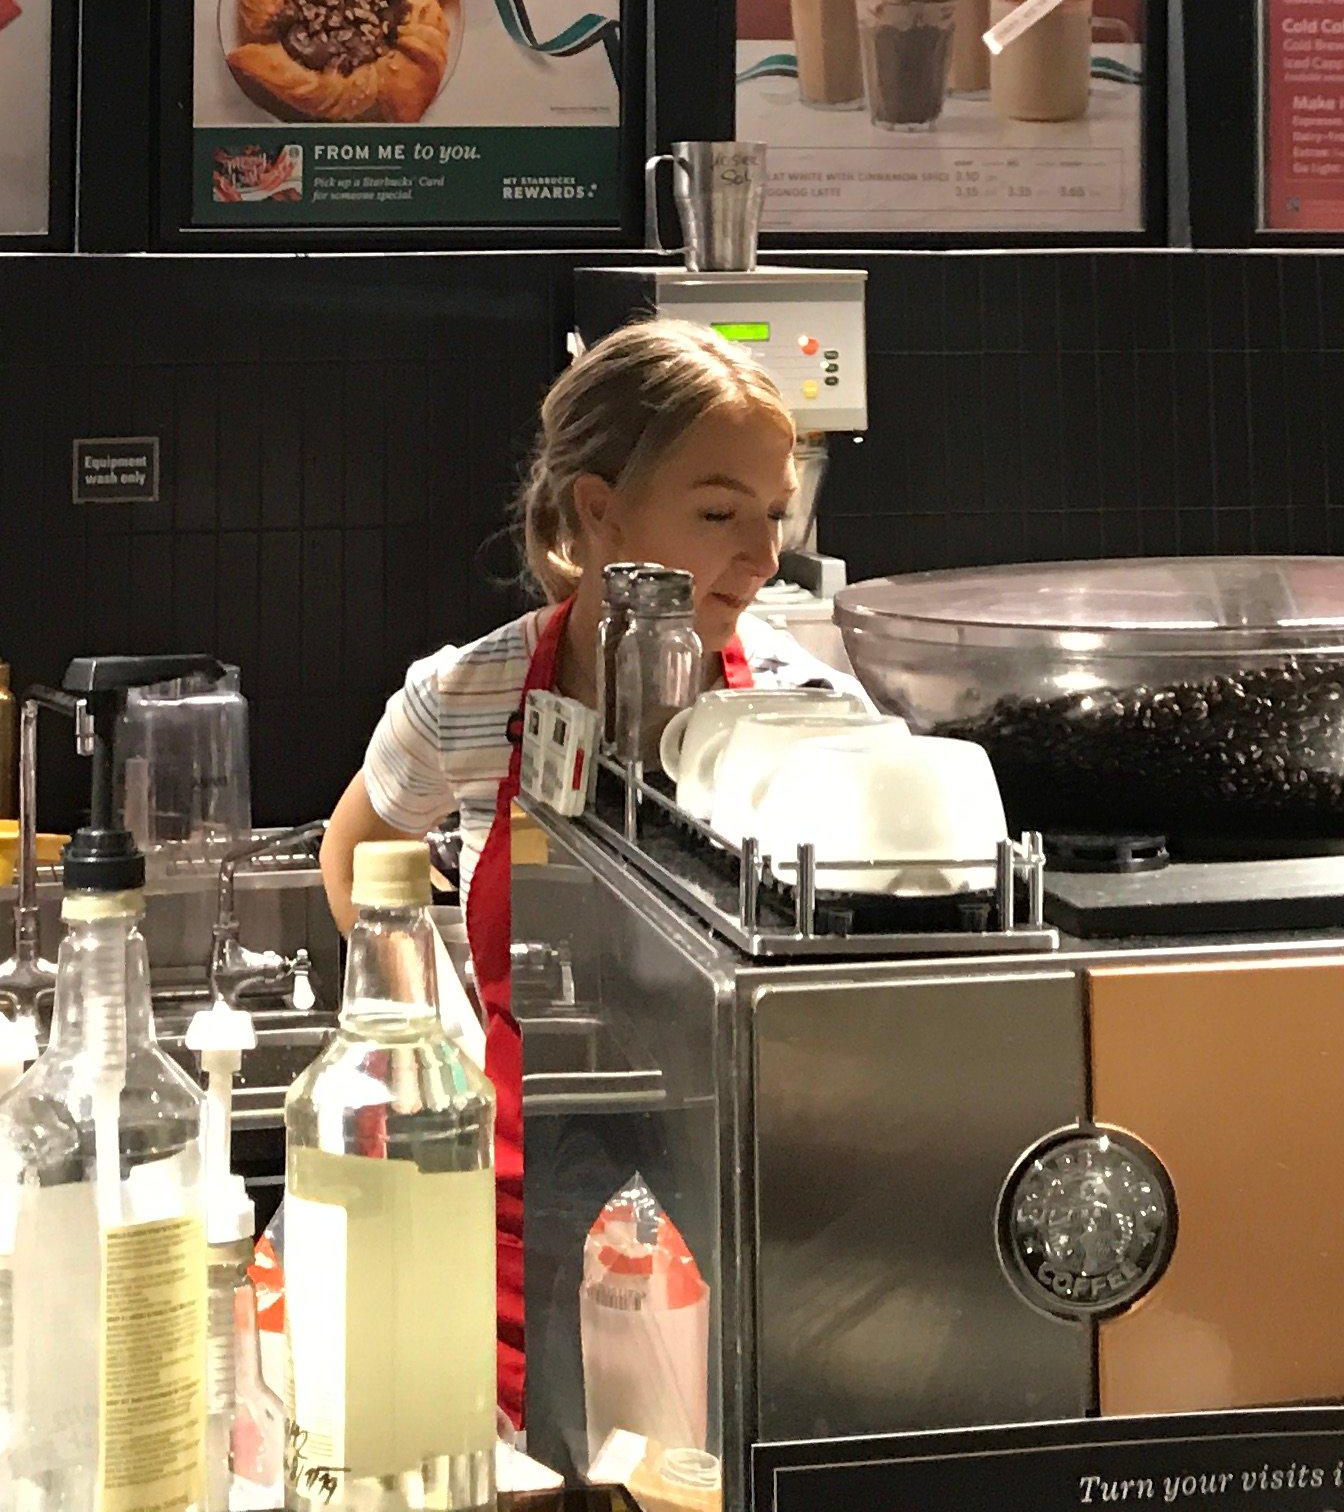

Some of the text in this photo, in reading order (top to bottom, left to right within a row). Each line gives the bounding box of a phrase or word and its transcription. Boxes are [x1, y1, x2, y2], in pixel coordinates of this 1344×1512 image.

[1282, 18, 1317, 33] Cold
[1293, 96, 1335, 110] Make
[314, 143, 481, 164] FROM ME to you.
[314, 177, 335, 187] Pick
[337, 179, 352, 189] up
[418, 176, 445, 187] Card
[787, 172, 822, 181] WHITE
[826, 172, 854, 181] WITH
[858, 172, 918, 181] CINNAMON
[313, 191, 328, 202] for
[330, 192, 375, 200] someone
[502, 186, 585, 199] REWARDS
[812, 189, 842, 197] LATTE
[84, 454, 147, 471] Equipment
[85, 471, 146, 486] wash only
[1037, 1260, 1144, 1301] COFFEE
[1079, 1475, 1155, 1504] Turn
[1163, 1472, 1233, 1504] your
[1241, 1460, 1325, 1493] visits
